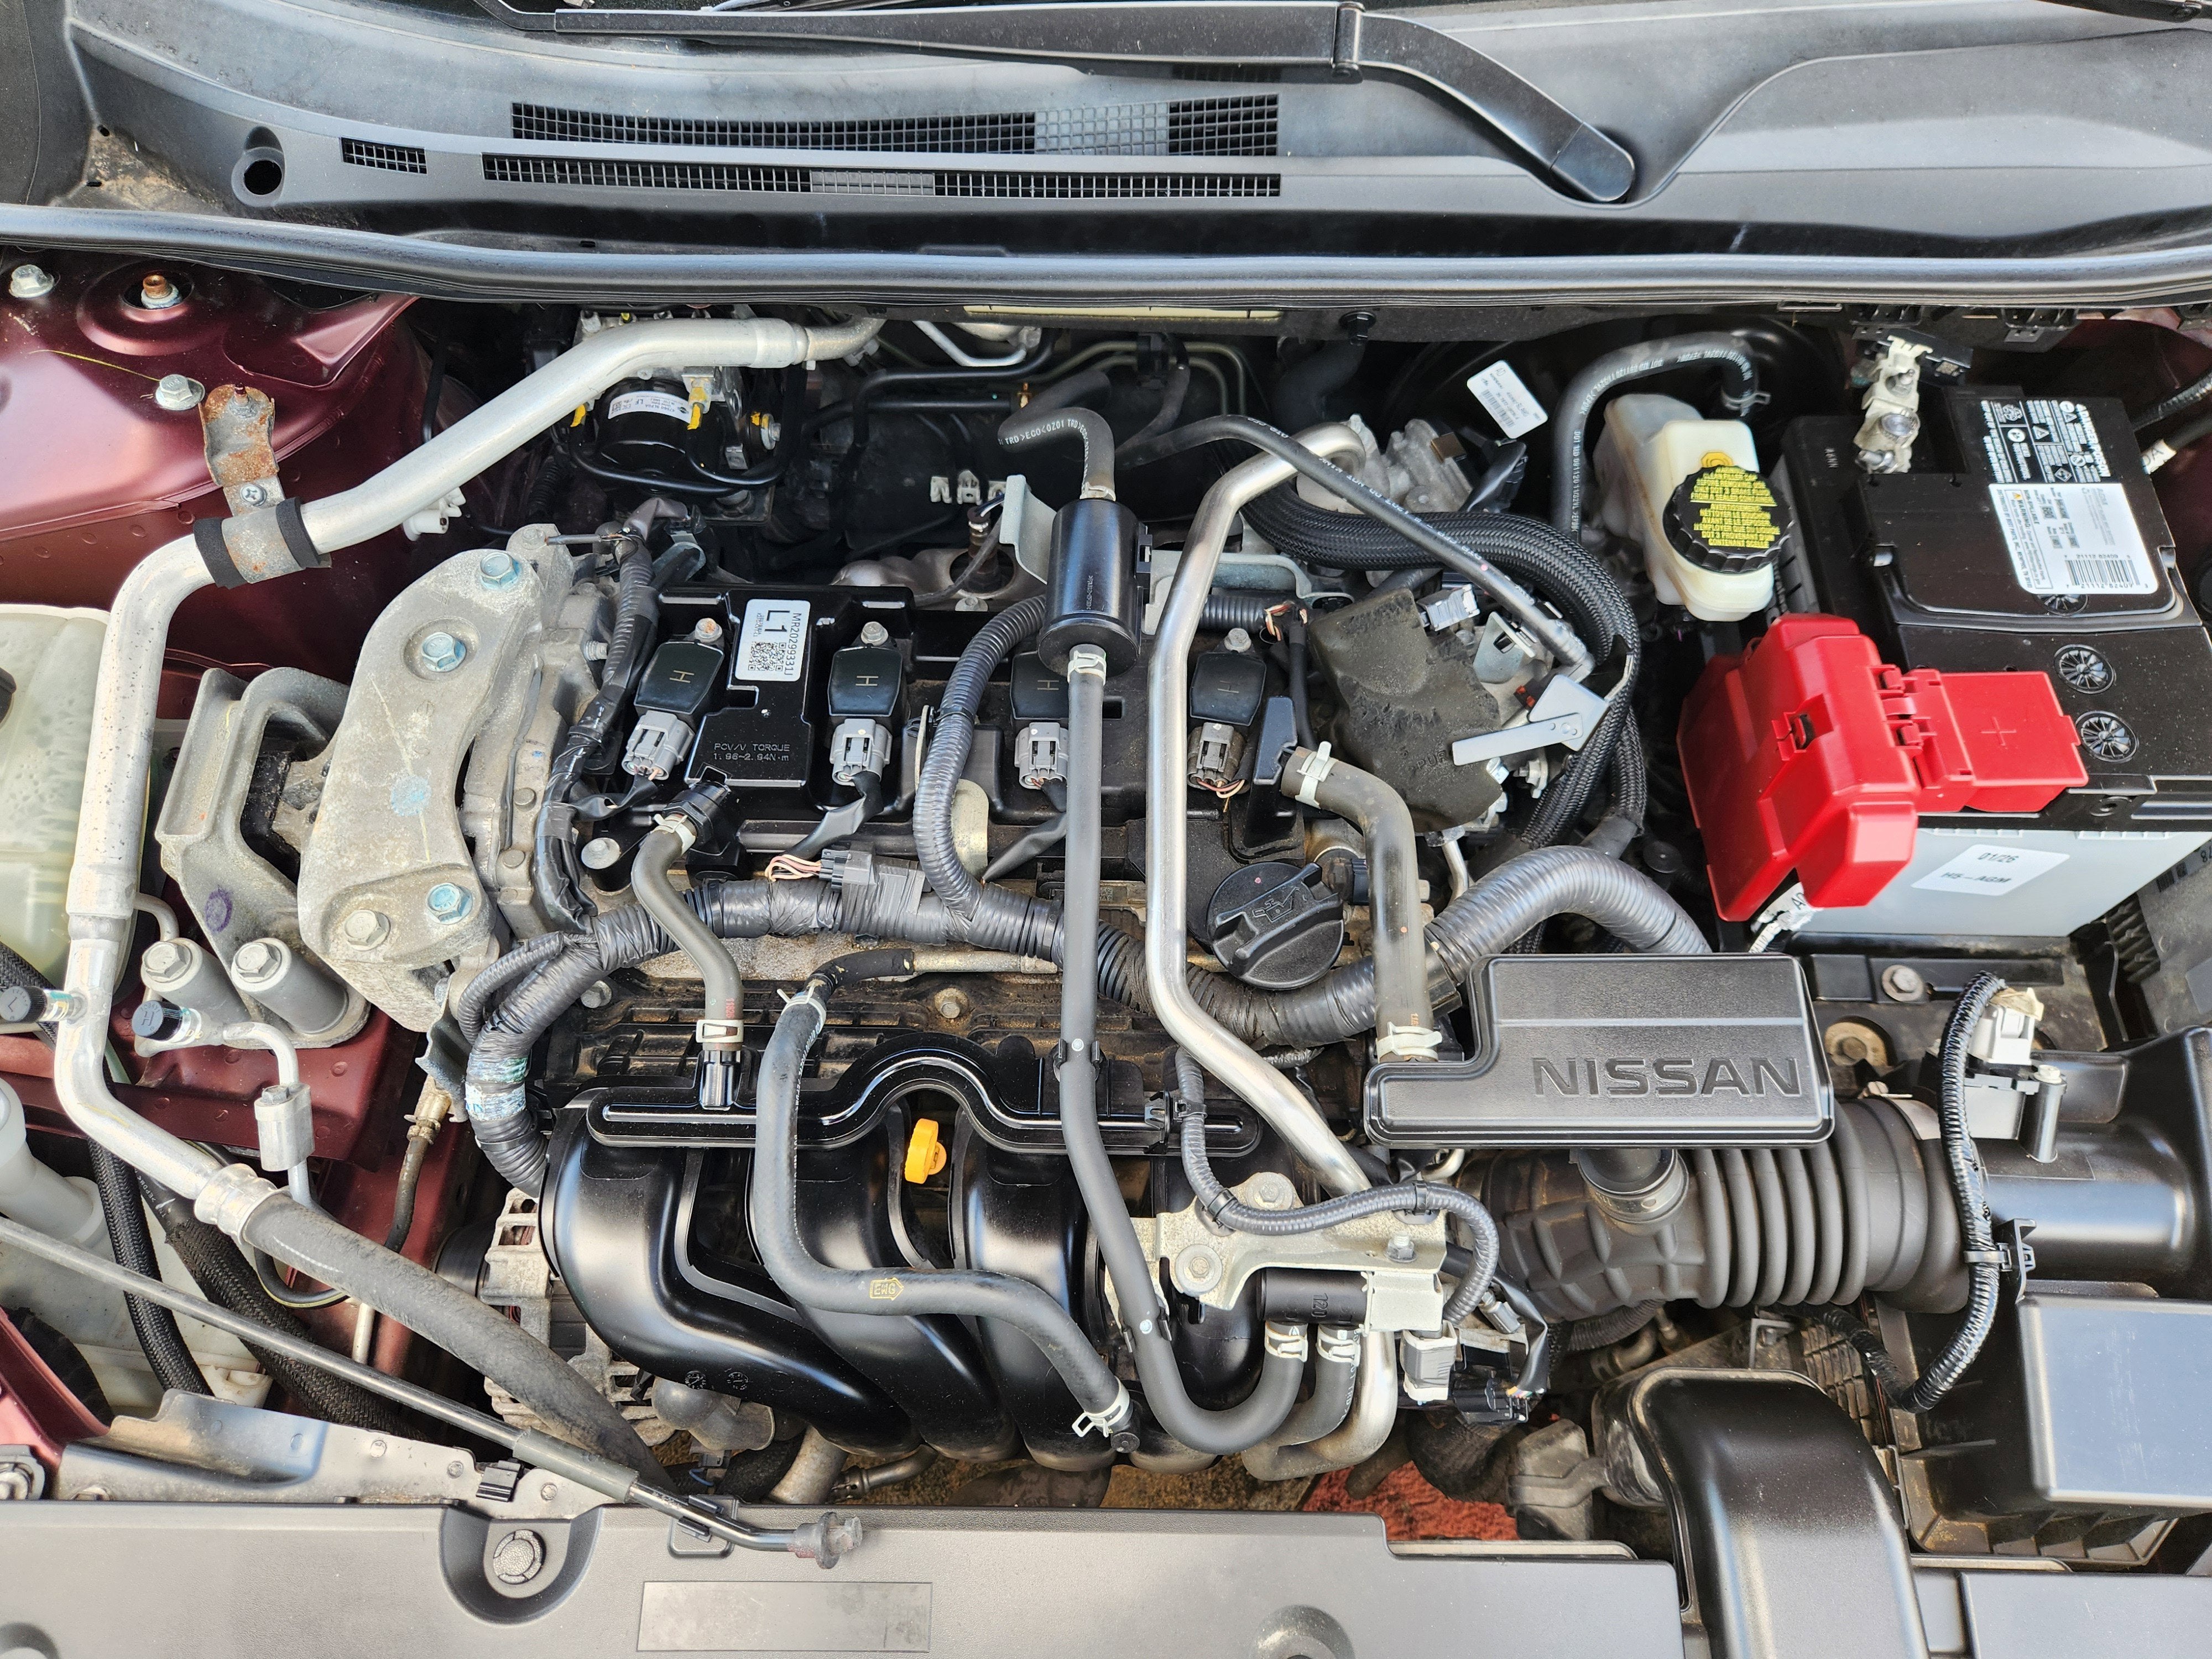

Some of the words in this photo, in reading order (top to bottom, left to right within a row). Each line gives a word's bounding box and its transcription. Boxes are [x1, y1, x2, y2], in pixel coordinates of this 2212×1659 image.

[1005, 436, 1019, 445] TRD
[1708, 538, 1745, 546] CONTENANT
[784, 613, 801, 676] MR20299331J
[713, 742, 747, 752] PCV/V
[753, 742, 791, 753] TORQUE
[1978, 852, 2020, 863] 01/26
[1533, 1057, 1802, 1097] NISSAN
[137, 1175, 156, 1203] >EPDM<
[1311, 1293, 1328, 1318] 120
